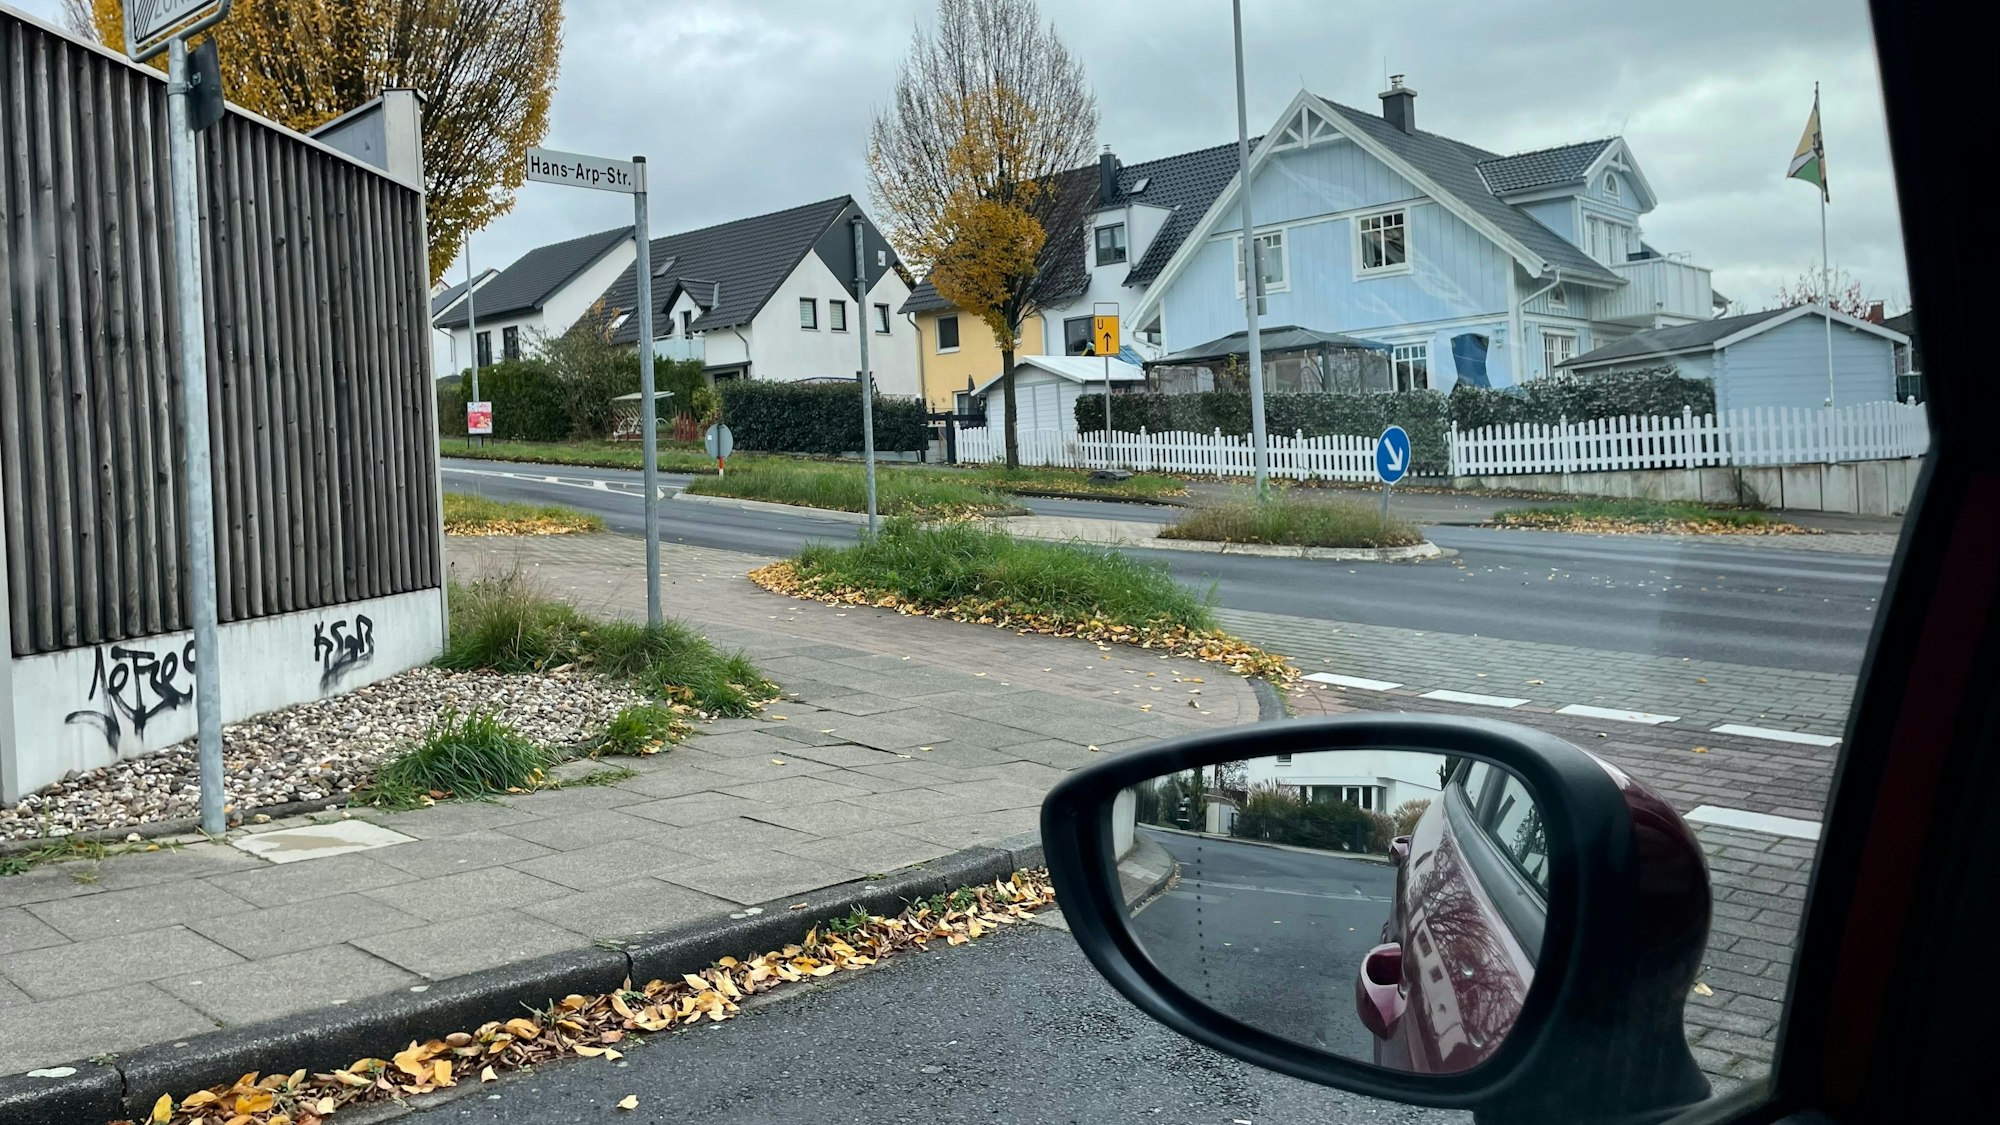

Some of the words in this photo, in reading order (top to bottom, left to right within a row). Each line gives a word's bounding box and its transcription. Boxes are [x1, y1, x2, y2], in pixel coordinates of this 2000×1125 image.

[154, 0, 191, 19] ZO
[530, 155, 632, 186] Hans-Arp-Str.
[1097, 318, 1104, 330] U
